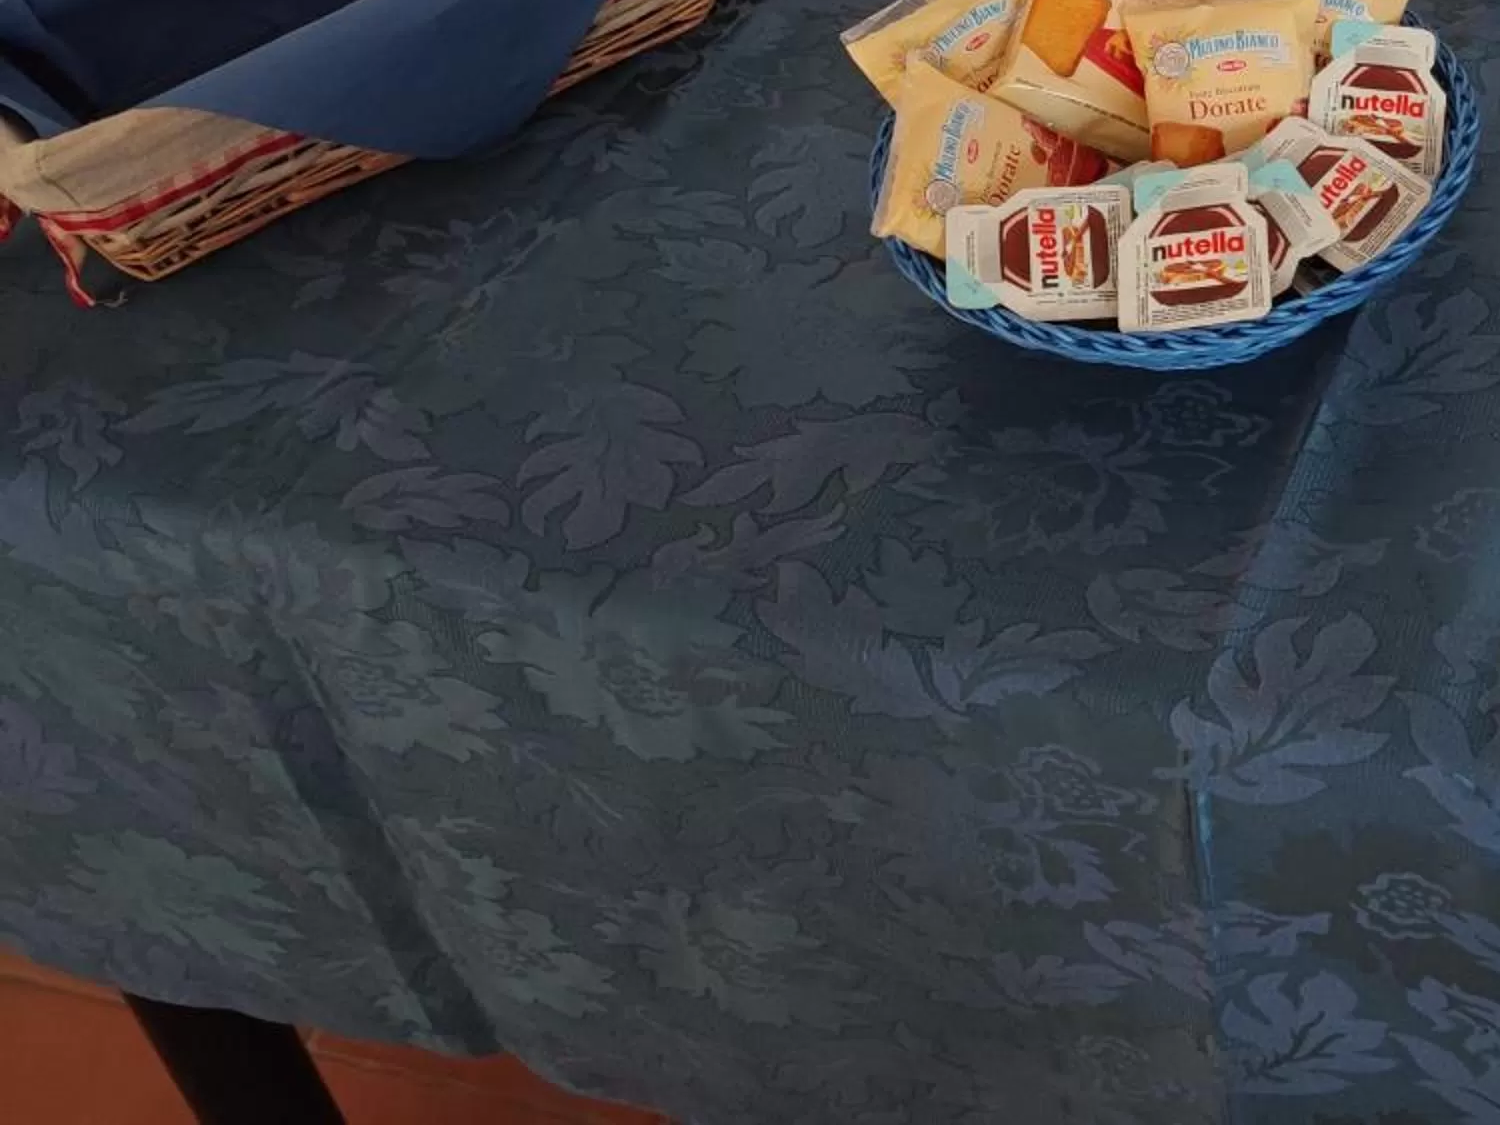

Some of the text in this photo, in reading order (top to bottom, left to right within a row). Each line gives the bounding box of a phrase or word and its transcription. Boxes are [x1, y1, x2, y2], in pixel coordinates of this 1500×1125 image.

[1189, 96, 1267, 121] Dorate
[1341, 92, 1426, 119] nutella
[1319, 156, 1367, 210] utella
[1032, 207, 1060, 290] nutella
[1152, 232, 1245, 262] nutella
